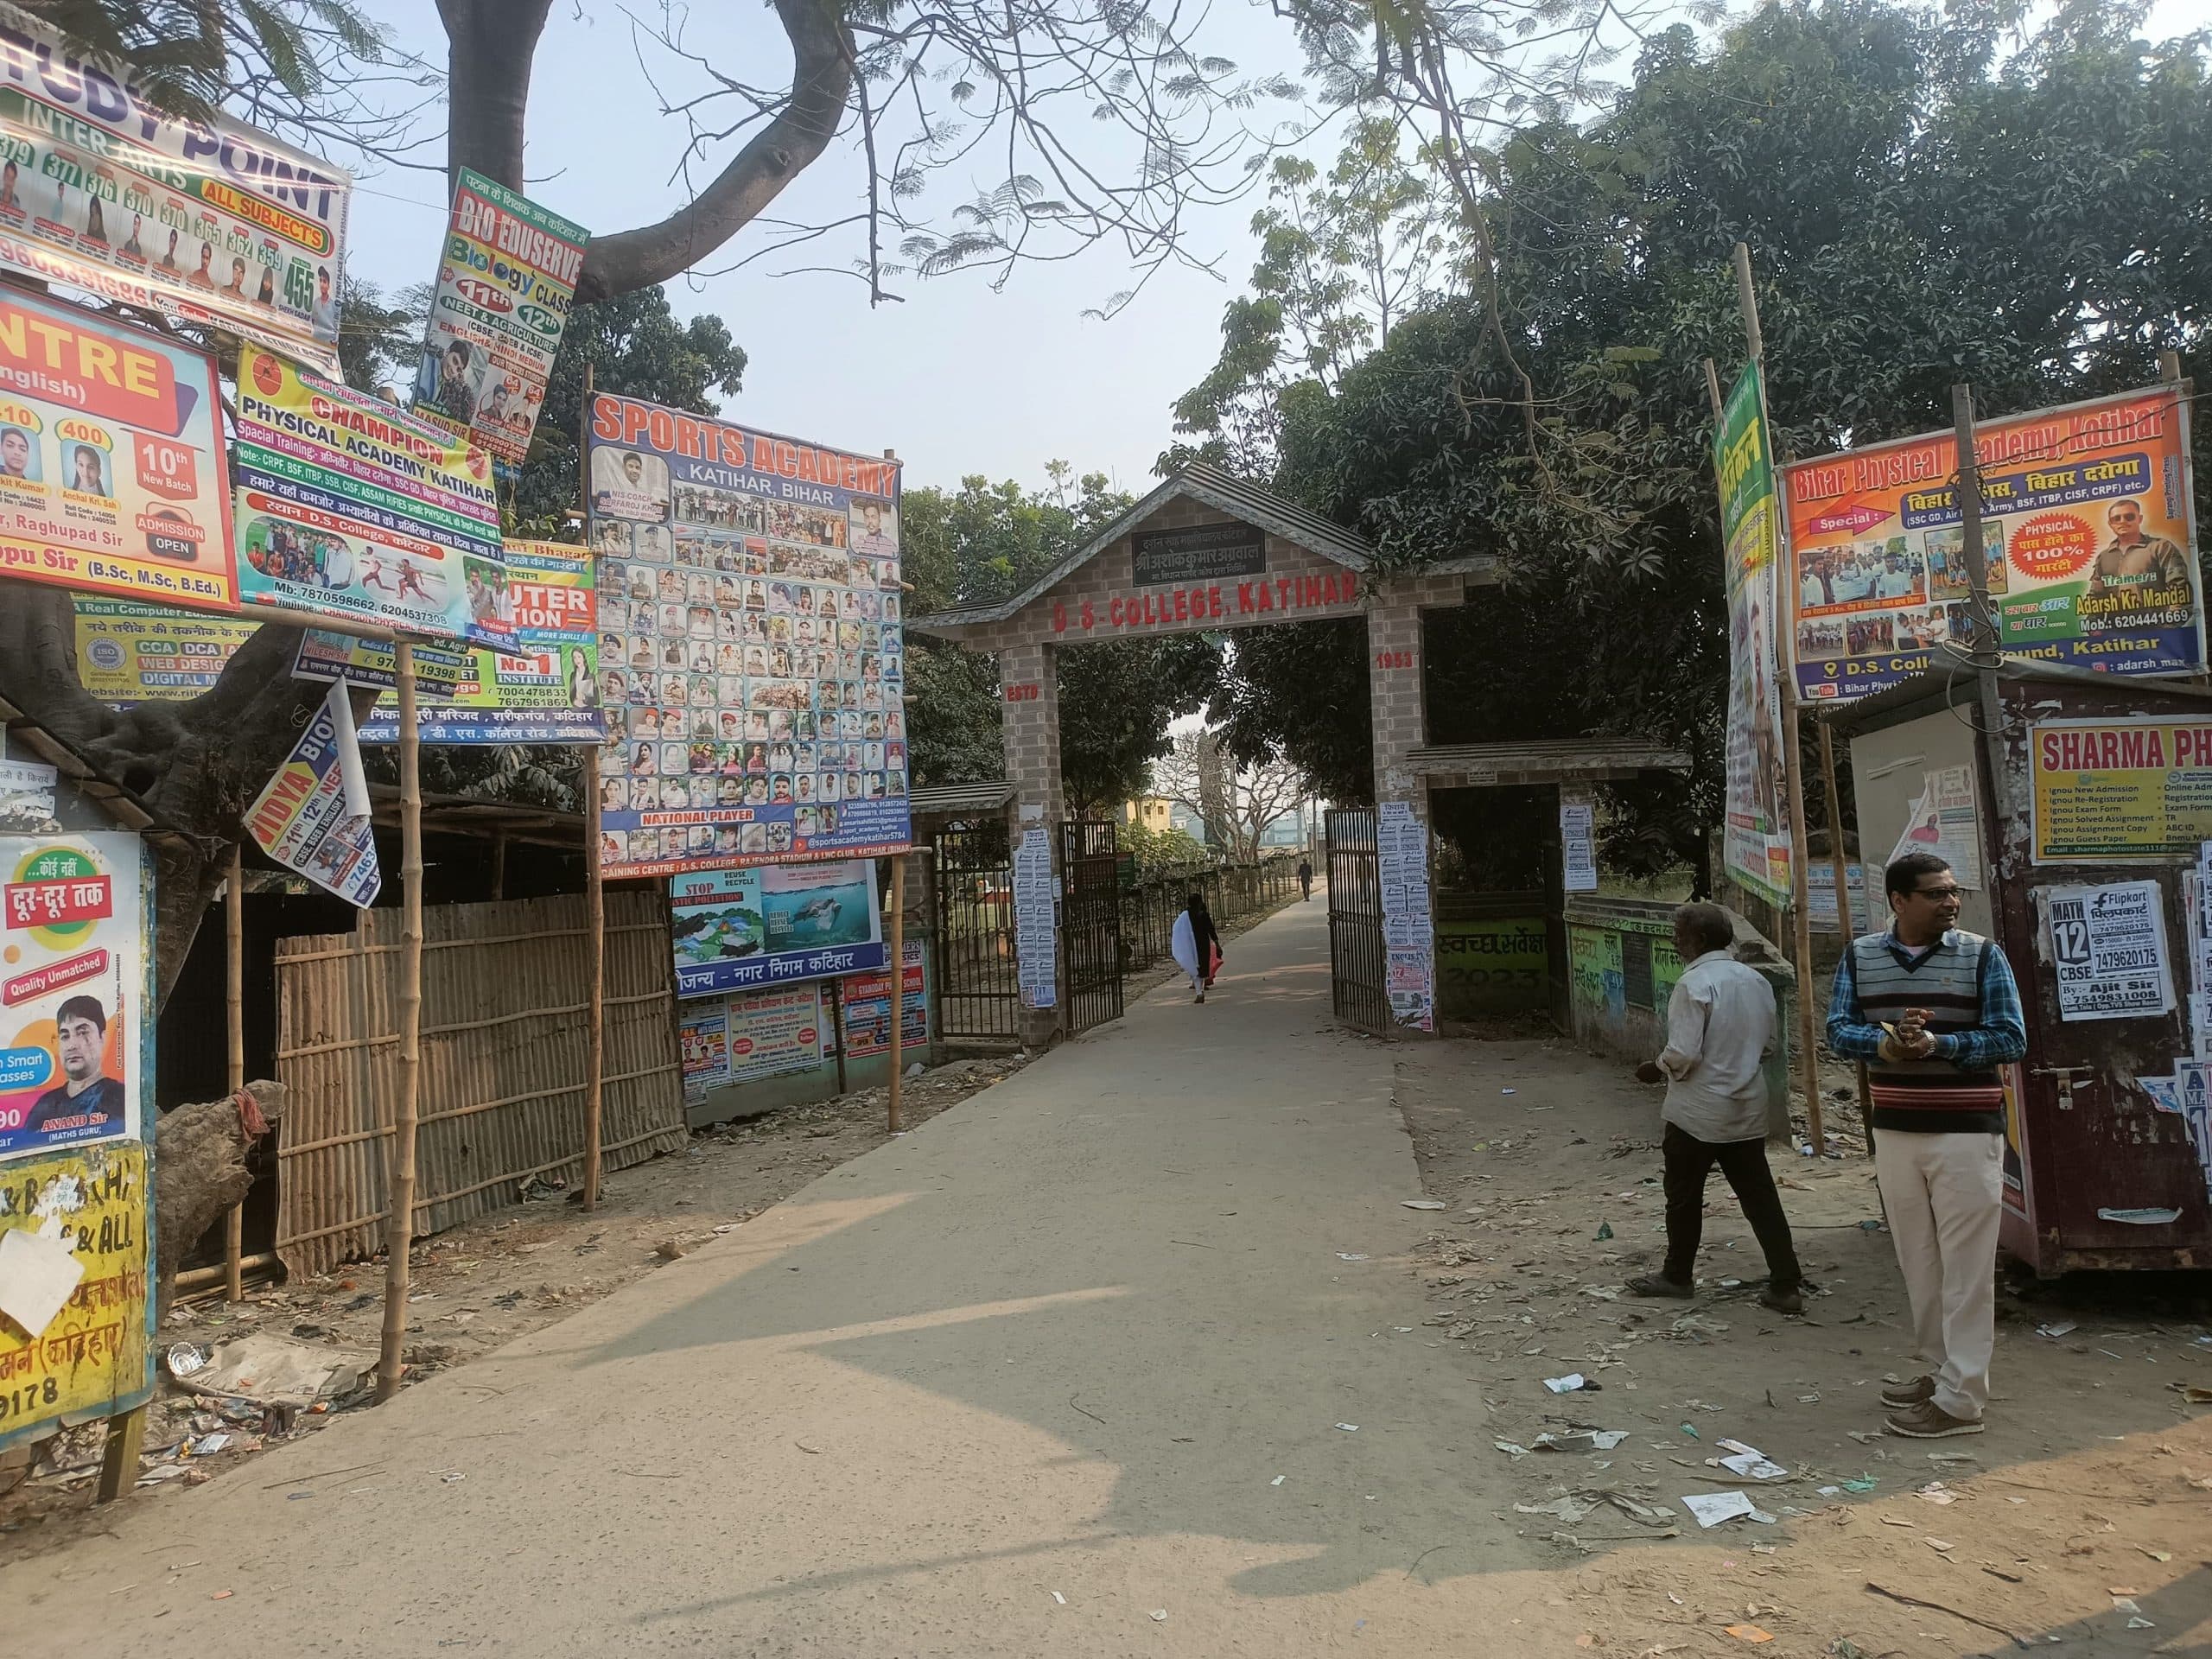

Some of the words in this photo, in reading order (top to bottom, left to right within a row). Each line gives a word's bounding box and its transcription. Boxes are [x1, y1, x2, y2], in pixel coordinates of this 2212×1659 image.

[22, 99, 113, 159] INTER
[183, 119, 340, 219] POINT
[87, 175, 115, 200] 376
[467, 175, 491, 197] पटना
[125, 187, 153, 217] 370
[161, 203, 188, 230] 370
[204, 181, 238, 212] ALL
[239, 195, 323, 248] SUBJECT'S
[195, 219, 222, 245] 365
[458, 195, 496, 242] BIO
[498, 213, 584, 285] EDUSERVE
[227, 235, 253, 258] 362
[259, 244, 283, 270] 359
[283, 261, 315, 315] 455
[536, 284, 571, 316] CLASS
[459, 280, 511, 308] 11th
[523, 305, 560, 332] 12th
[443, 296, 479, 318] NEET
[480, 309, 489, 324] &
[491, 315, 556, 353] AGRICULTURE
[518, 353, 546, 373] MEDIUM
[418, 398, 442, 411] Guided
[63, 422, 103, 444] 400
[311, 395, 443, 467] CHAMPION
[453, 424, 467, 439] SIR
[142, 442, 187, 476] 10th
[242, 396, 340, 448] PHYSICAL
[346, 438, 427, 480] ACADEMY
[429, 468, 495, 505] KATIHAR
[593, 395, 747, 468] SPORTS
[752, 435, 899, 499] ACADEMY
[1795, 469, 1847, 502] Bihar
[1853, 450, 1944, 492] Physical
[2069, 404, 2165, 451] Katihar
[16, 480, 45, 493] Kumar
[143, 472, 164, 486] New
[165, 477, 192, 493] Batch
[395, 478, 409, 491] SSC
[690, 463, 777, 498] KATIHAR,
[782, 480, 834, 505] BIHAR
[361, 486, 385, 503] ASSAM
[423, 503, 454, 525] PHYSICAL
[1820, 512, 1872, 531] Special
[1906, 490, 1954, 512] बिहार
[2025, 469, 2078, 493] बिहार
[2083, 459, 2141, 484] दरोगा
[1988, 500, 2015, 513] Army,
[2092, 485, 2122, 498] CRPF)
[2125, 481, 2145, 492] etc.
[250, 474, 275, 493] हमारे
[300, 488, 334, 510] कमजोर
[432, 528, 452, 544] समय
[454, 532, 471, 548] दिया
[16, 514, 98, 542] Raghupad
[103, 533, 123, 547] Sir
[137, 517, 204, 541] ADMISSION
[309, 512, 335, 528] D.S.
[339, 519, 389, 544] College,
[393, 535, 431, 555] कटिहार
[2024, 520, 2076, 536] PHYSICAL
[2068, 533, 2085, 543] का
[156, 537, 189, 554] OPEN
[2023, 545, 2084, 561] 100%
[44, 550, 79, 572] Sir
[88, 560, 133, 582] (B.Sc,
[137, 569, 176, 590] M.Sc,
[181, 575, 221, 598] B.Ed.)
[2035, 558, 2072, 572] गारंटी
[274, 582, 298, 596] Mb:
[1237, 572, 1357, 614] KATIHAR
[2075, 594, 2118, 617] Adarsh
[2144, 583, 2190, 608] Mandal
[86, 603, 115, 614] Real
[118, 603, 182, 617] Computer
[2114, 608, 2189, 629] 6204441669
[111, 621, 146, 633] तरीके
[172, 626, 216, 637] तकनीक
[2023, 616, 2047, 629] पार
[138, 641, 174, 654] CCA
[183, 643, 217, 656] DCA
[1847, 661, 1885, 676] D.S.
[2073, 638, 2160, 656] Katihar
[141, 658, 175, 670] WEB
[143, 672, 203, 685] DIGITAL
[498, 674, 562, 683] INSTITUTE
[1845, 683, 1869, 693] Bihar
[553, 709, 593, 722] कटिहार
[2043, 730, 2165, 772] SHARMA
[302, 793, 321, 821] 12th
[641, 810, 708, 827] NATIONAL
[709, 809, 753, 822] PLAYER
[2105, 815, 2154, 823] Assignment
[2076, 825, 2124, 834] Assignment
[2103, 835, 2127, 843] Paper
[641, 864, 676, 875] CENTRE
[740, 855, 779, 868] RAJENDRA
[780, 852, 813, 863] STADIUM
[857, 846, 887, 856] KATIHAR
[72, 882, 105, 906] तक
[685, 883, 714, 895] STOP
[2052, 901, 2084, 921] MATH
[2109, 891, 2146, 906] Flipkart
[2056, 922, 2088, 960] 12
[734, 964, 765, 982] नगर
[768, 957, 804, 977] निगम
[809, 951, 854, 971] कटिहार
[2096, 948, 2157, 969] 7479620175
[10, 977, 46, 997] Quality
[48, 956, 100, 983] Unmatched
[2060, 966, 2092, 981] CBSE
[2074, 990, 2157, 1003] 7549831008
[2089, 983, 2120, 993] Ajit
[2127, 981, 2154, 989] Sir
[7, 1055, 42, 1068] Smart
[41, 1114, 88, 1132] ANAND
[89, 1112, 108, 1125] Sir
[99, 1211, 133, 1254] ALL
